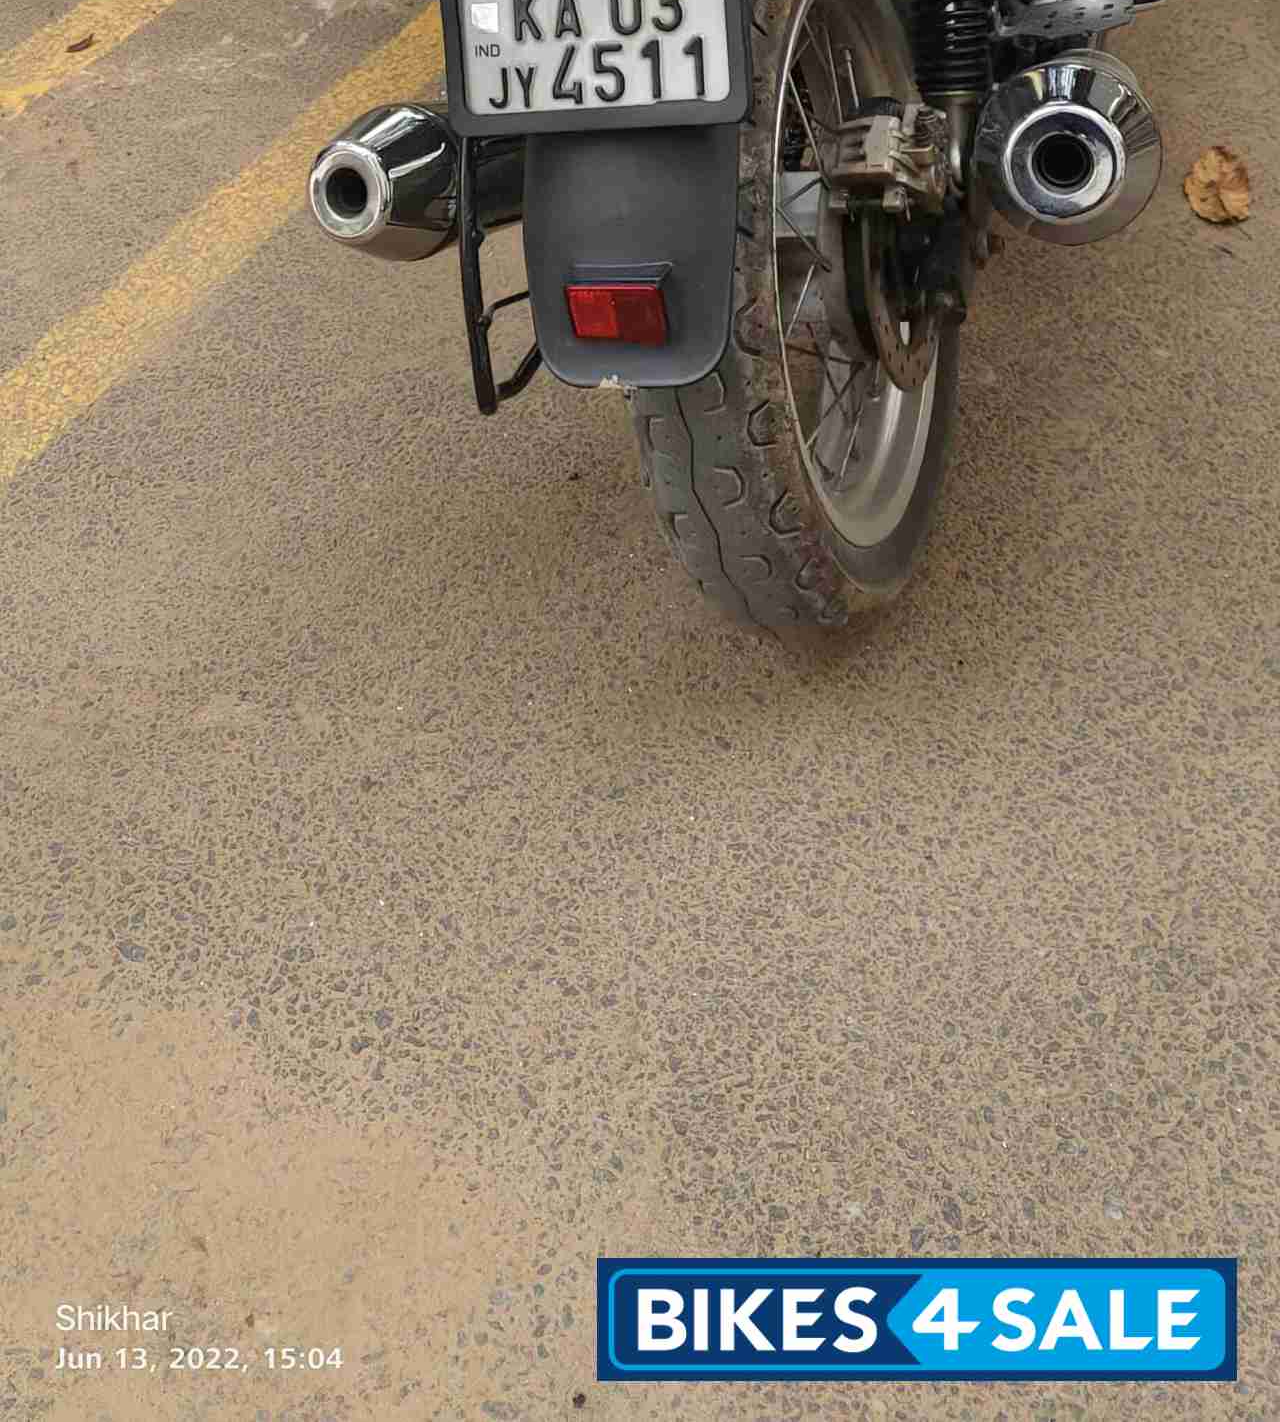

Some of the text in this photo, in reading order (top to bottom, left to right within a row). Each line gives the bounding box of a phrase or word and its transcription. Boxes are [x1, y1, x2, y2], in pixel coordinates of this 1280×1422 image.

[474, 43, 501, 58] IND
[489, 34, 706, 109] JY 4511
